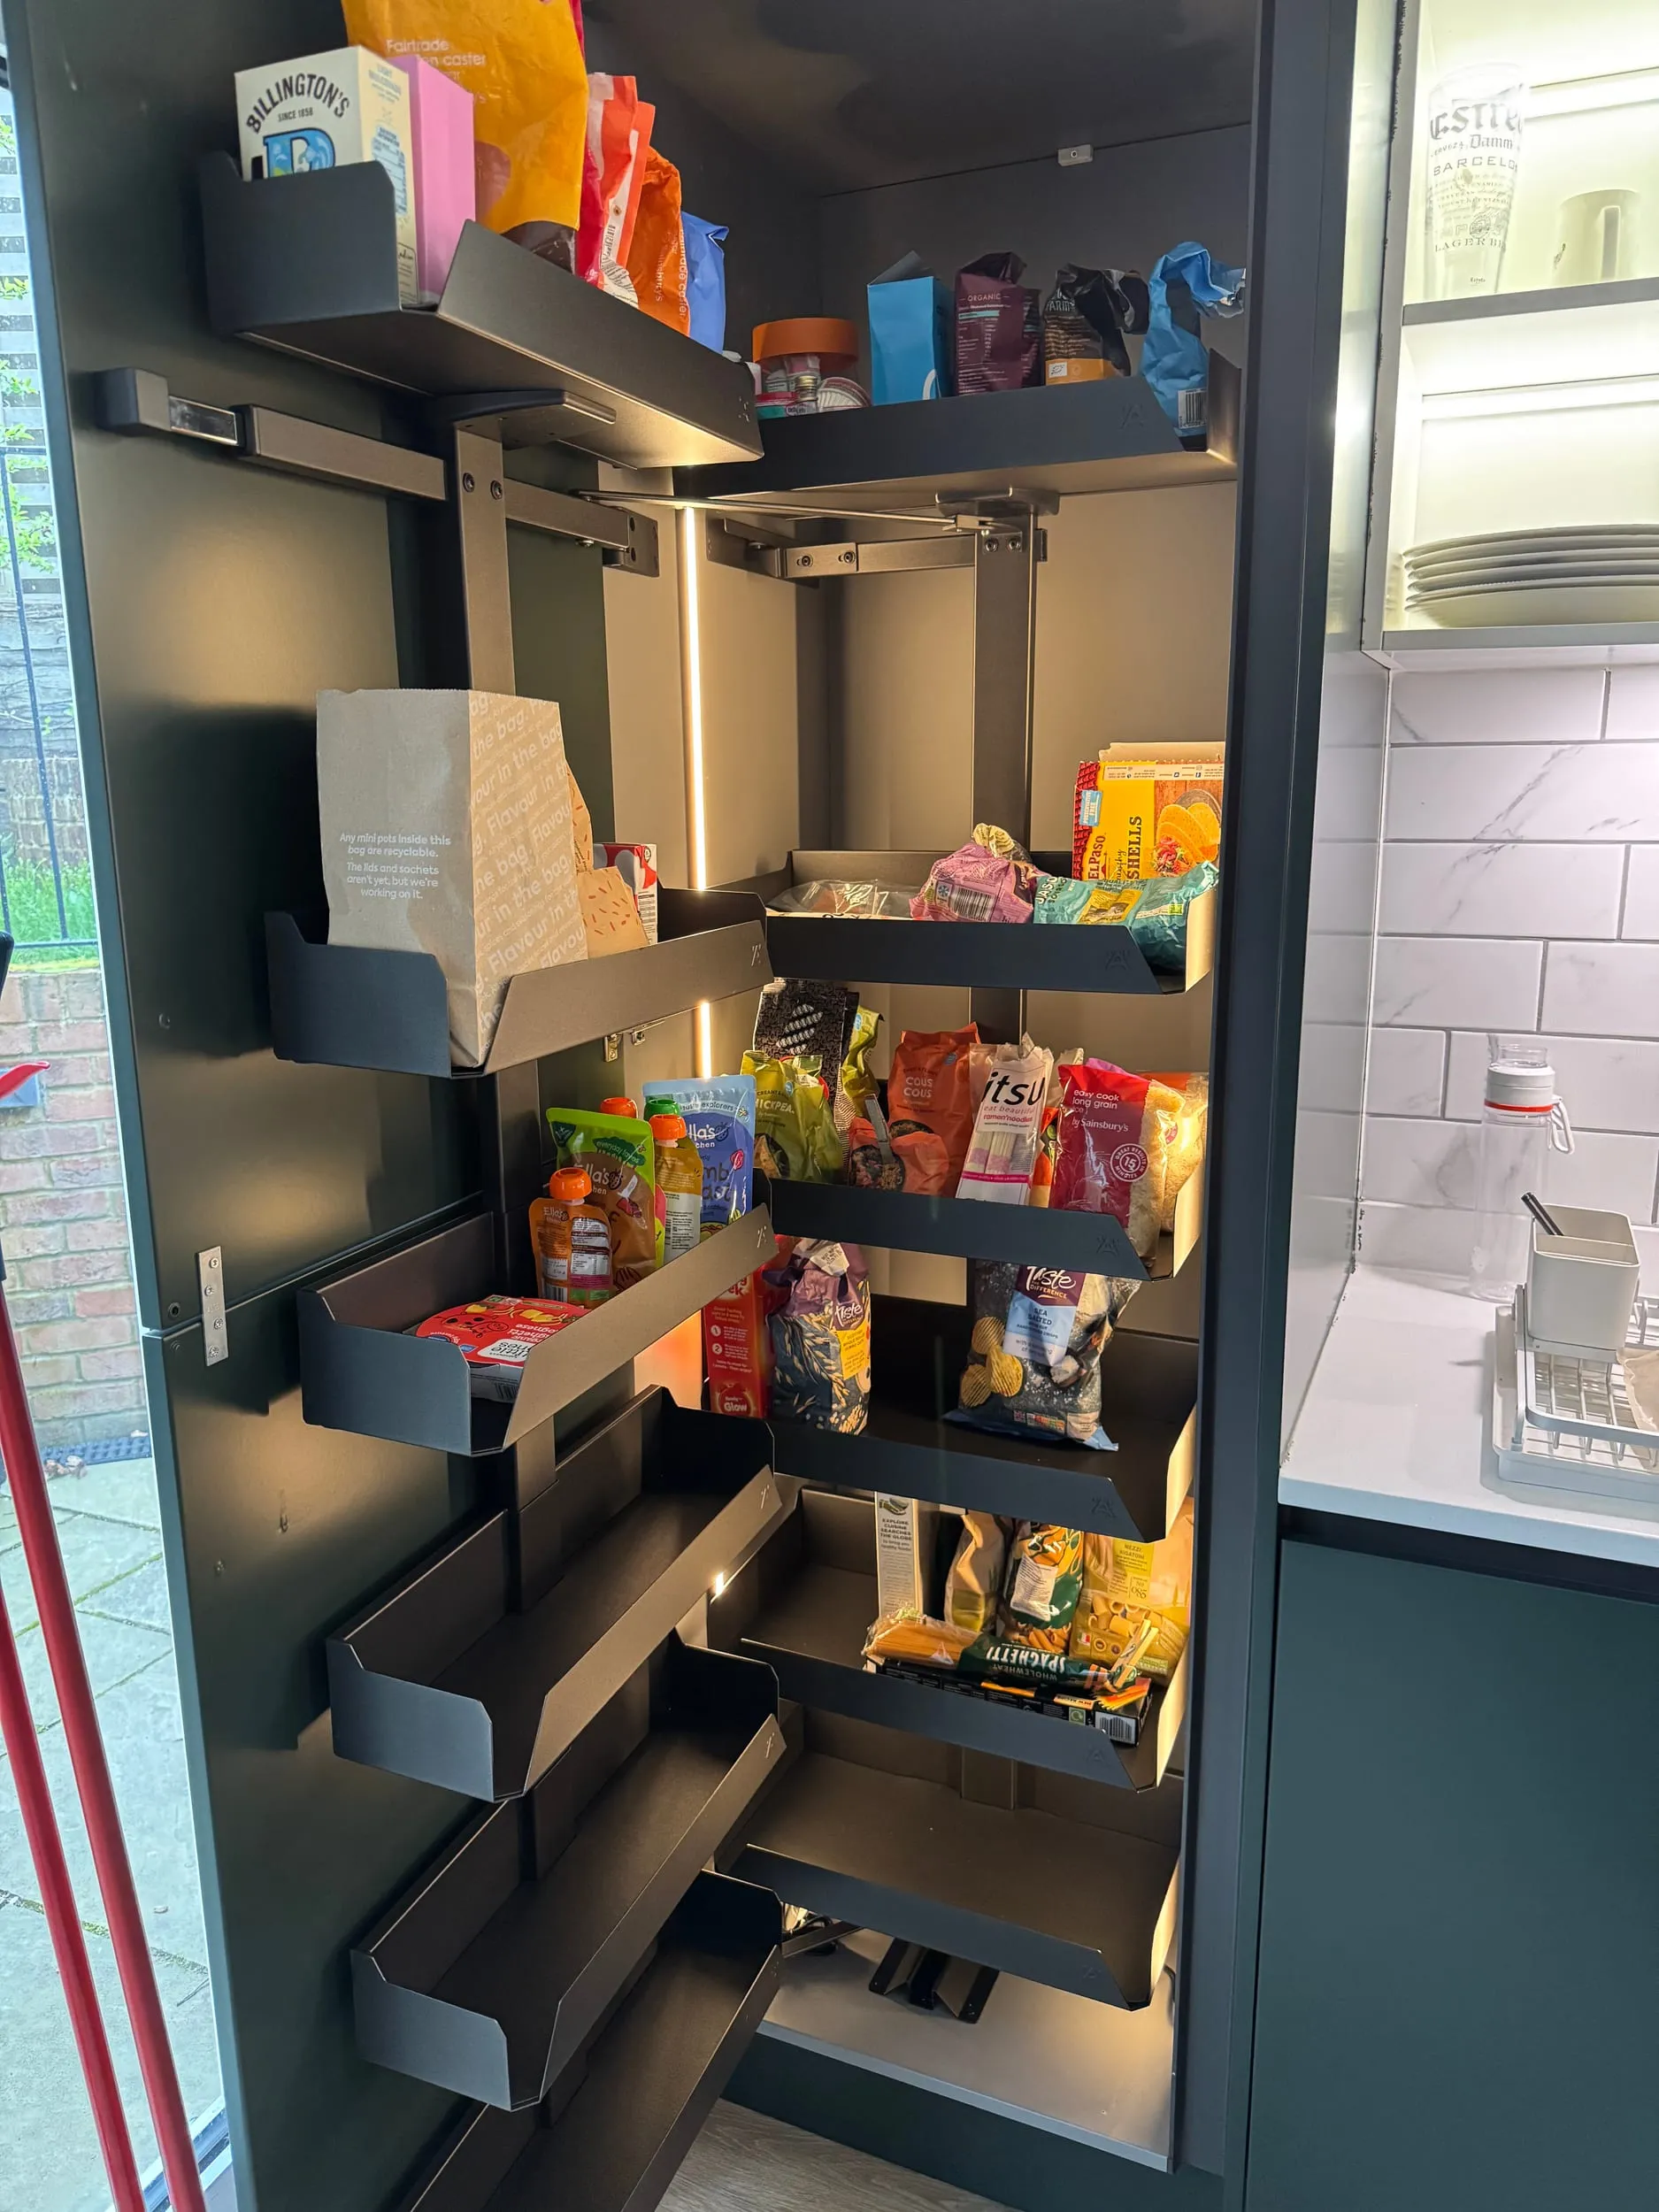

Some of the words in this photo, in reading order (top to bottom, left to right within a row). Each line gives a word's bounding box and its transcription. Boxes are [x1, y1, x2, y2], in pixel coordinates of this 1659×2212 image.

[386, 39, 450, 52] Fairtrade
[443, 54, 487, 66] caster
[246, 73, 350, 134] BILLINGTON'S
[278, 110, 296, 122] SINCE
[1470, 134, 1514, 150] Damm
[1433, 156, 1518, 177] BARCELO
[967, 292, 1002, 302] ORGANIC
[473, 733, 495, 760] the
[496, 709, 529, 741] bag.
[496, 764, 513, 784] in
[513, 743, 539, 770] the
[487, 786, 539, 837] Flavour
[540, 772, 555, 794] in
[531, 803, 572, 847] Flavou
[340, 833, 355, 844] Any
[357, 833, 376, 842] mini
[377, 833, 396, 845] pots
[398, 833, 428, 844] inside
[430, 834, 451, 845] this
[348, 845, 365, 856] bag
[383, 847, 439, 857] recyclable.
[1127, 816, 1142, 879] SHELLS
[347, 862, 362, 872] The
[364, 863, 379, 872] lids
[380, 864, 397, 873] and
[399, 864, 440, 875] sachets
[347, 875, 373, 885] aren't
[392, 876, 408, 886] but
[410, 877, 439, 887] we're
[360, 887, 396, 900] working
[413, 889, 424, 899] it.
[1035, 876, 1058, 904] JASO
[492, 902, 512, 925] in
[511, 881, 542, 910] the
[488, 918, 549, 975] Flavour
[549, 903, 565, 926] in
[540, 925, 588, 970] Flavou
[905, 1077, 933, 1087] COUS
[980, 1071, 1046, 1106] itsu
[903, 1087, 932, 1098] COUS
[1073, 1089, 1094, 1098] easy
[1095, 1092, 1119, 1102] cook
[703, 1102, 733, 1112] explorers
[1072, 1096, 1092, 1108] long
[1094, 1100, 1118, 1110] grain
[688, 1124, 716, 1141] lla's
[1071, 1117, 1080, 1129] by
[1080, 1118, 1129, 1133] Sainsbury's
[1124, 1156, 1137, 1169] 15
[1026, 1266, 1077, 1291] Taste
[1030, 1284, 1068, 1299] DIFFERENCE
[1028, 1314, 1052, 1325] SALTED
[1034, 1308, 1048, 1317] SEA
[986, 1646, 1067, 1671] SPAGHETTI
[992, 1664, 1057, 1681] WHOLEWHEAT
